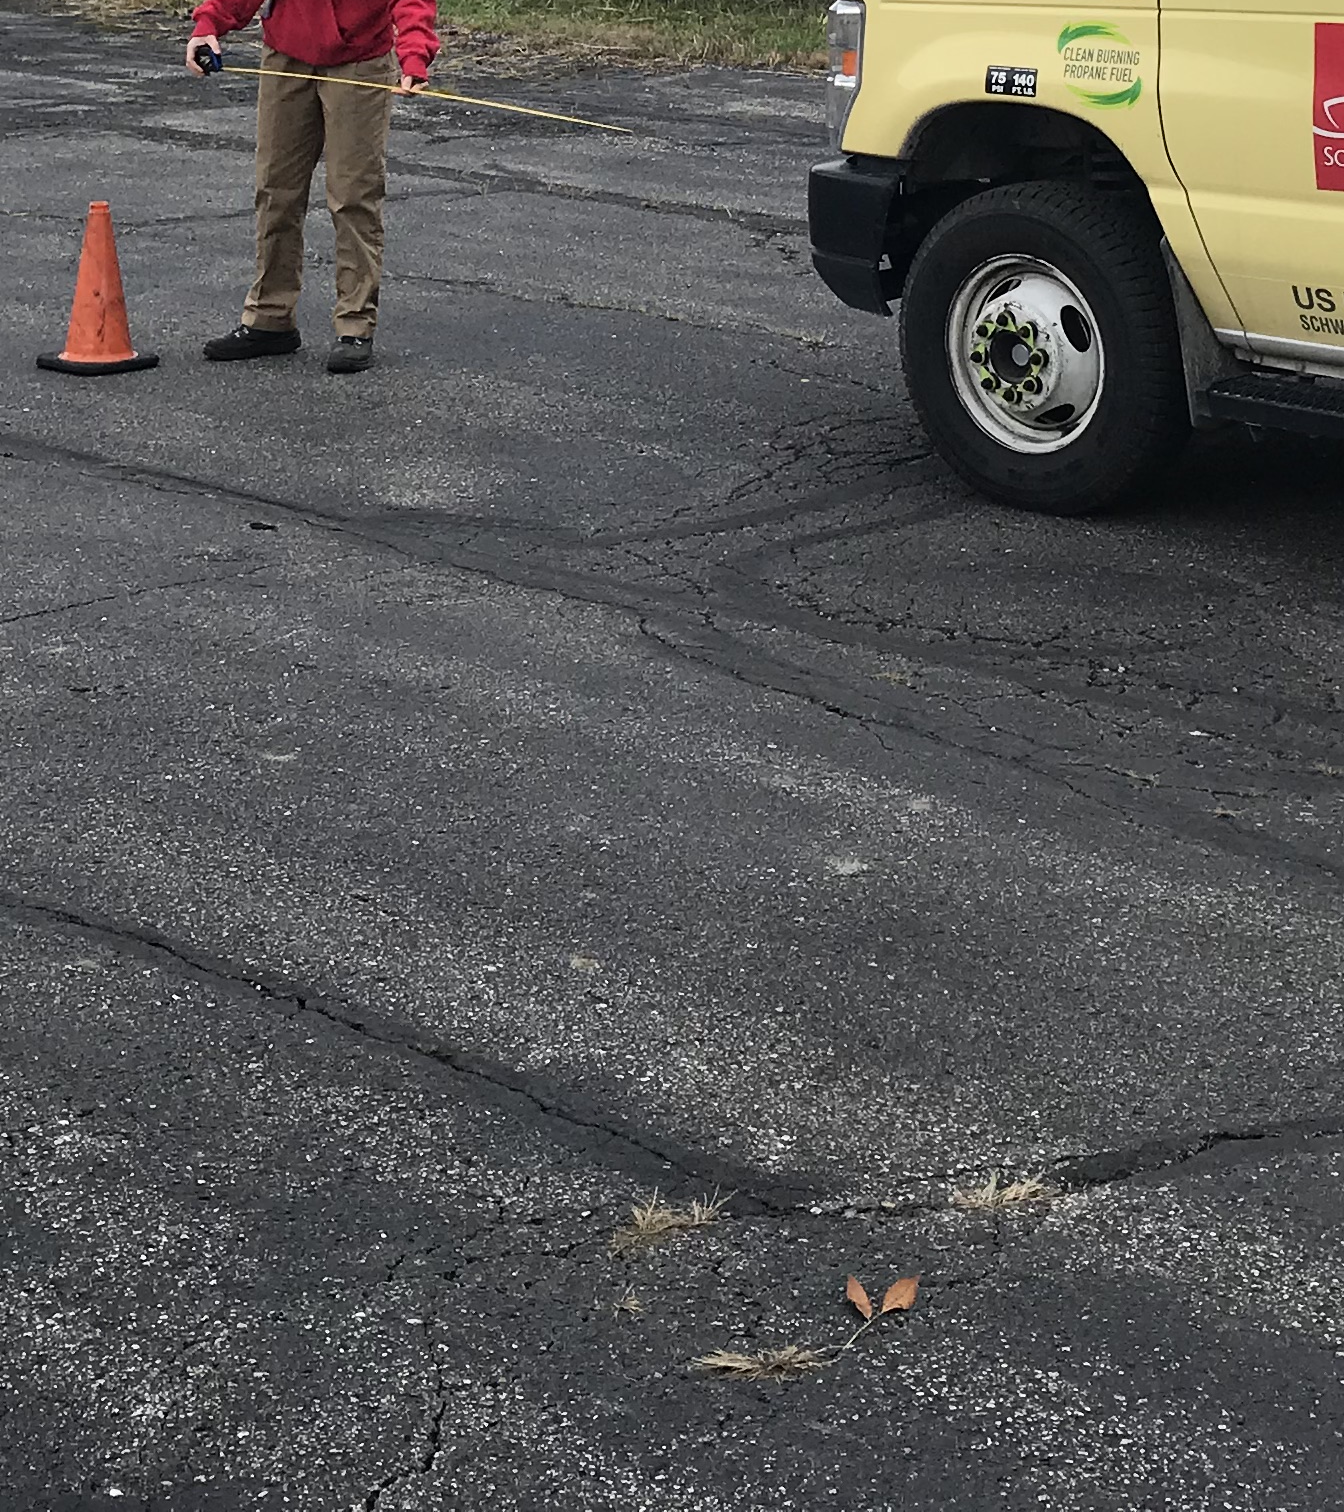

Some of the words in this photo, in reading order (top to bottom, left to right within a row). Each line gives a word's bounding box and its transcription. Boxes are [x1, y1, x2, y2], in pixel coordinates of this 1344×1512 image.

[1063, 47, 1094, 62] CLEAN
[1096, 48, 1141, 66] BURNING
[990, 71, 1007, 84] 75
[1012, 74, 1035, 86] 140
[1063, 64, 1108, 81] PROPANE
[1109, 67, 1134, 83] FUEL
[1291, 285, 1336, 313] US
